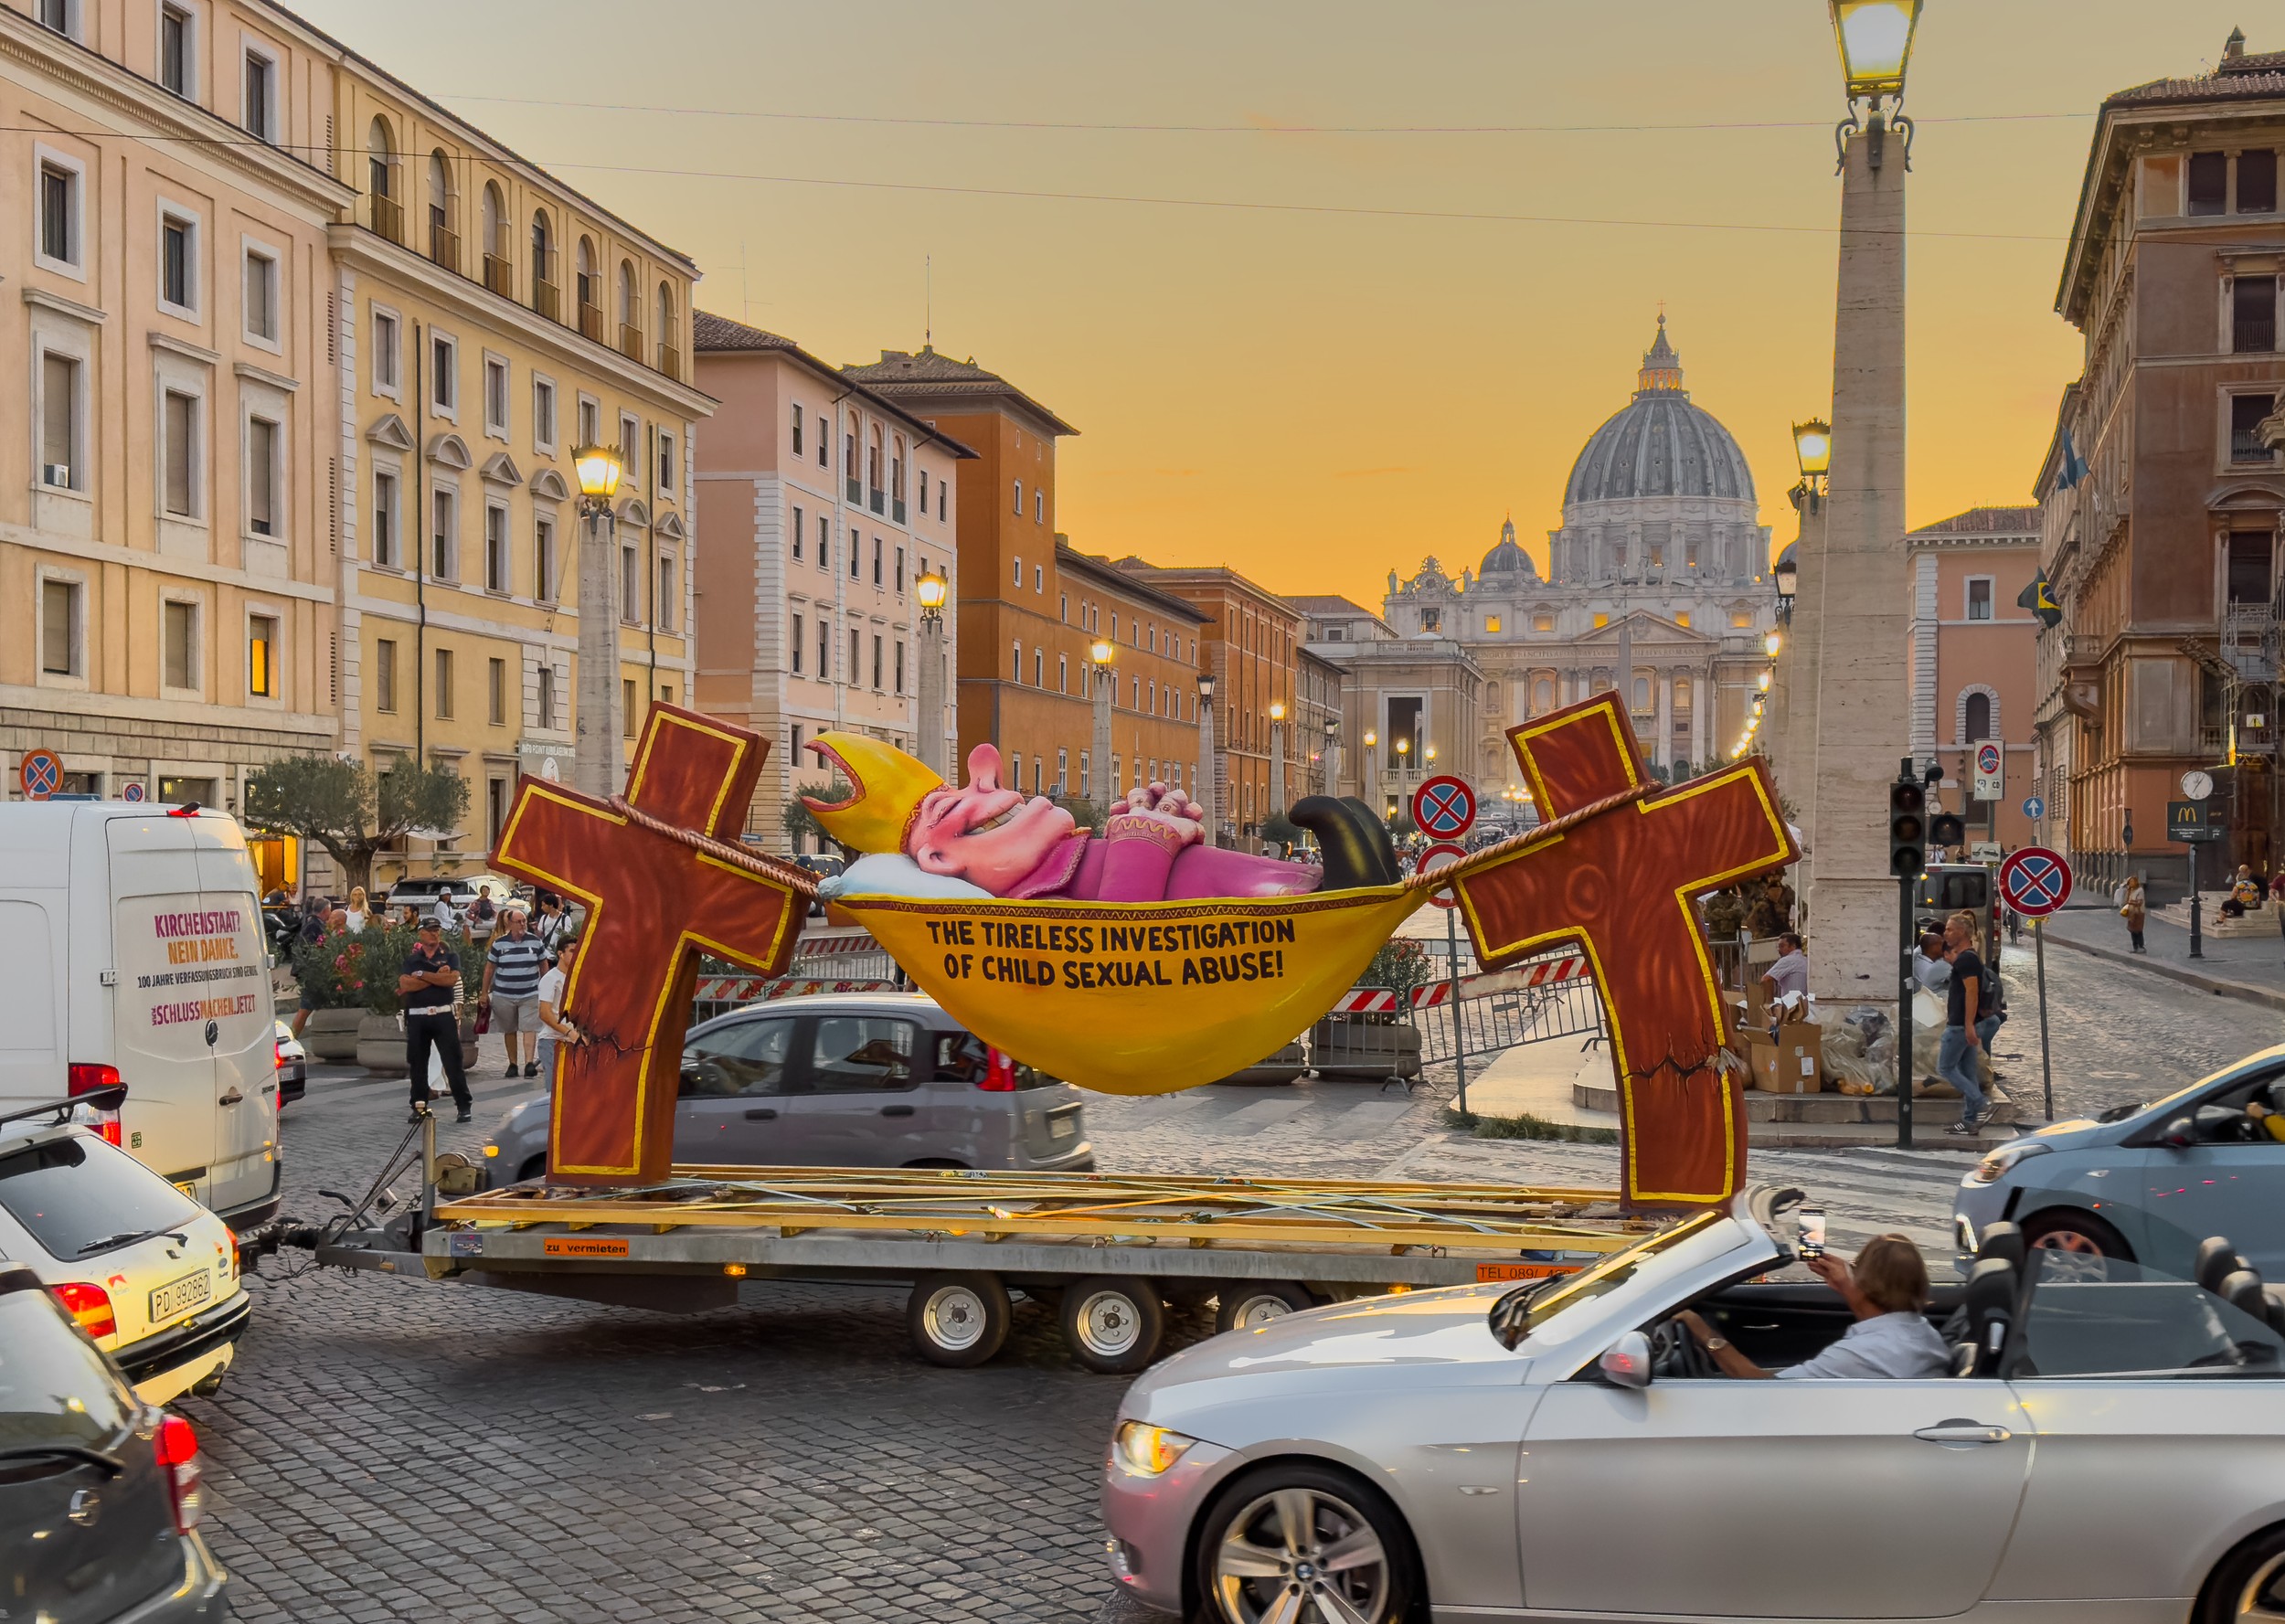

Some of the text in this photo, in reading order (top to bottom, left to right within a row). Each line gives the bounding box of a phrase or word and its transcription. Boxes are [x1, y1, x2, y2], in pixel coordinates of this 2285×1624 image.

[926, 919, 1295, 953] THE TIRELESS INVESTIGATION
[167, 937, 239, 964] NEIN DANKE.
[137, 975, 152, 988] 100
[152, 972, 175, 987] JAHRE
[175, 968, 232, 985] VERFASSUNGSBRUCH
[943, 950, 1284, 989] OF CHILD SEXUAL ABUSE!
[567, 1244, 626, 1253] vermieten
[1480, 1267, 1505, 1279] TEL
[155, 1274, 209, 1317] PD 992862
